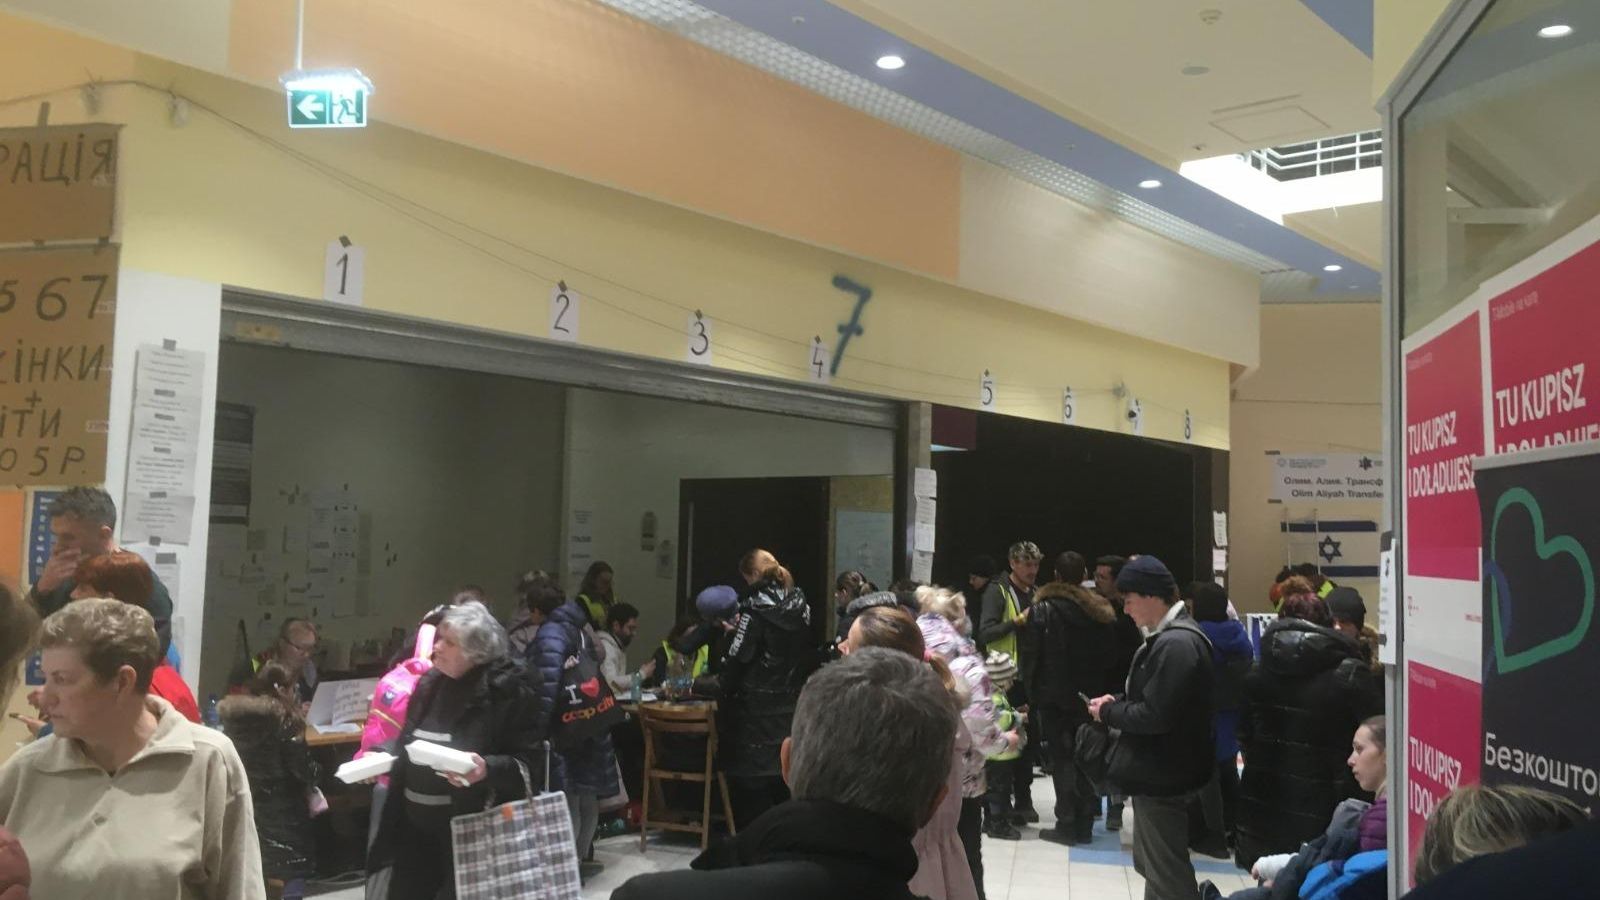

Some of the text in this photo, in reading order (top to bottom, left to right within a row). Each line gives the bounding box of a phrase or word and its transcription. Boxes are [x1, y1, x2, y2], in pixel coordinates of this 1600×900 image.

[336, 253, 349, 296] 1
[554, 293, 570, 334] 2
[830, 275, 872, 377] 7
[690, 320, 709, 356] 3
[0, 339, 104, 385] ІНКИ
[812, 346, 824, 379] 4
[982, 380, 993, 406] 5
[1064, 394, 1073, 419] 6
[1496, 363, 1586, 429] TU KUPISZ
[1183, 416, 1192, 440] 8
[1407, 423, 1421, 456] TU
[1421, 411, 1456, 452] KUPISZ
[1291, 489, 1313, 498] Olim
[1316, 489, 1344, 499] Aliyah
[565, 684, 582, 704] I
[1410, 736, 1462, 792] TU KUPISZ
[1484, 732, 1600, 797] Безкошто
